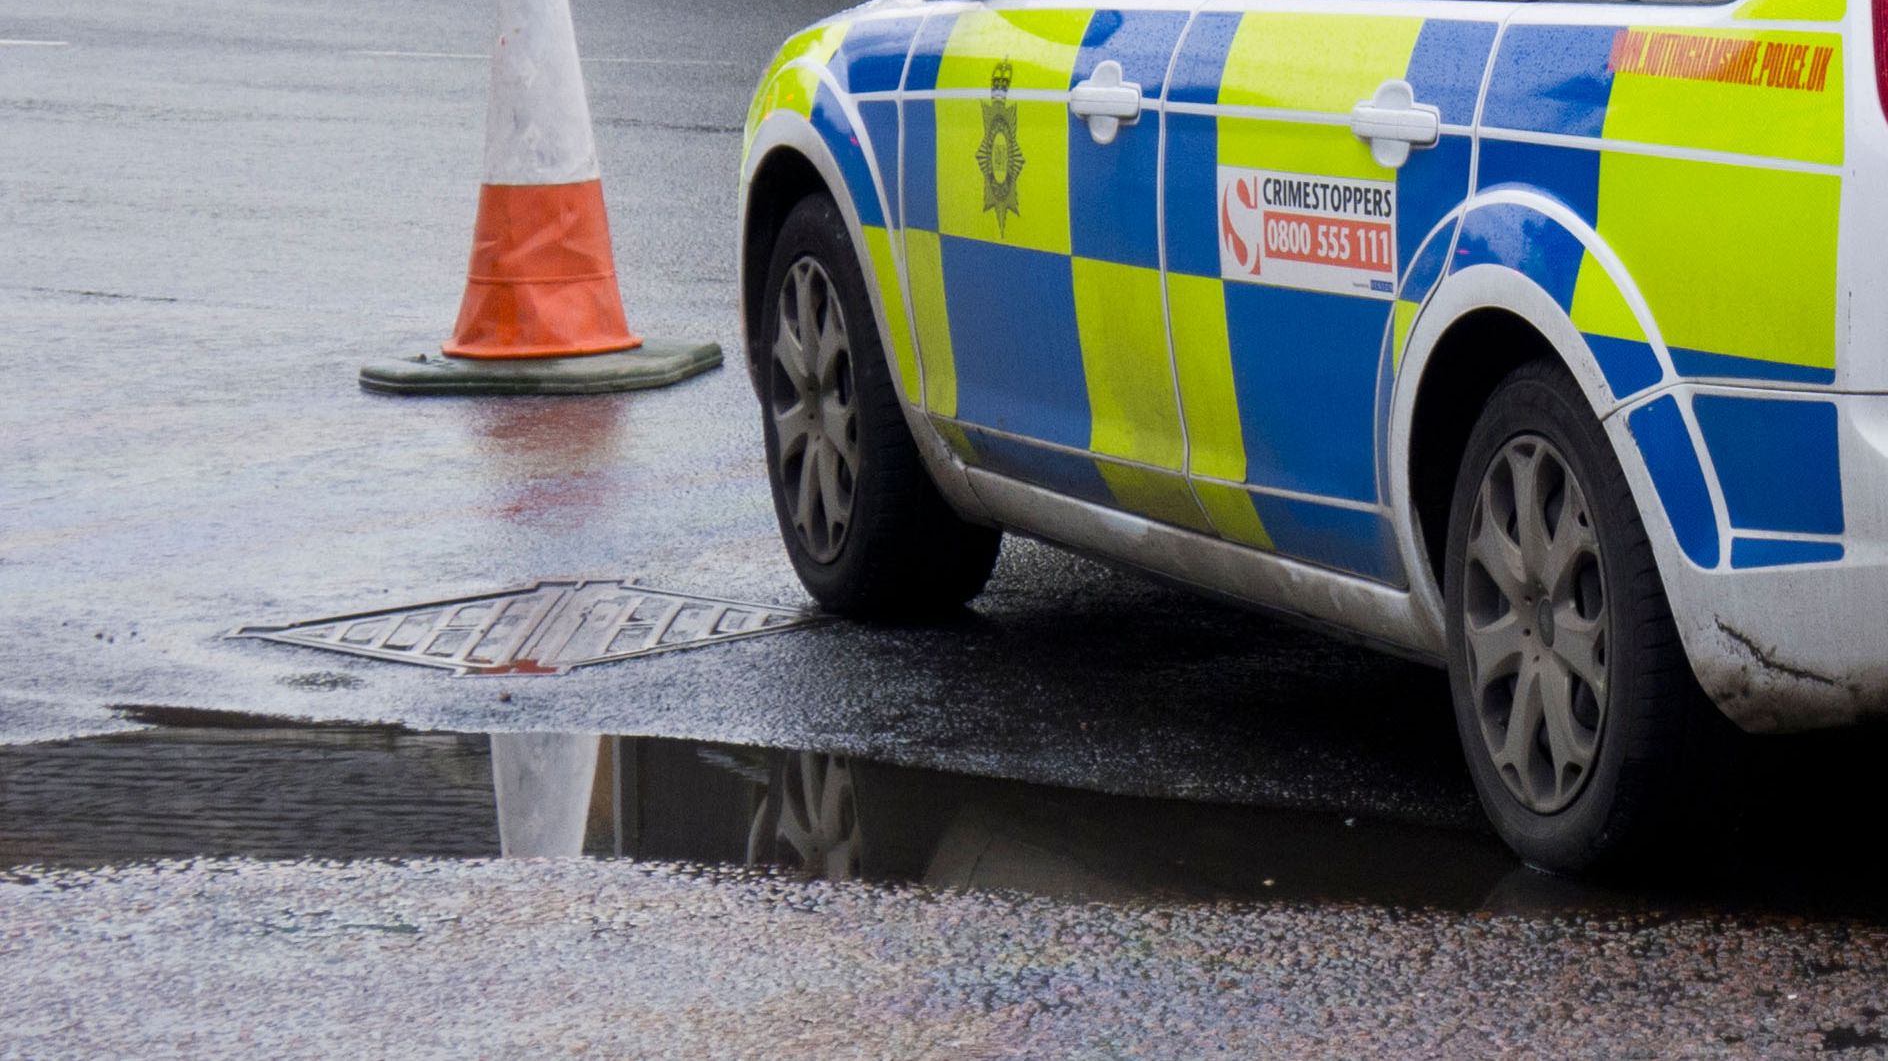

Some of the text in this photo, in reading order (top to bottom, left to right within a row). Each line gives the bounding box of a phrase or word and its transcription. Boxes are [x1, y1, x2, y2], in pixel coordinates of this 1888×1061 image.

[1263, 177, 1392, 218] CRIMESTOPPERS
[1267, 218, 1390, 265] 0800 555 111
